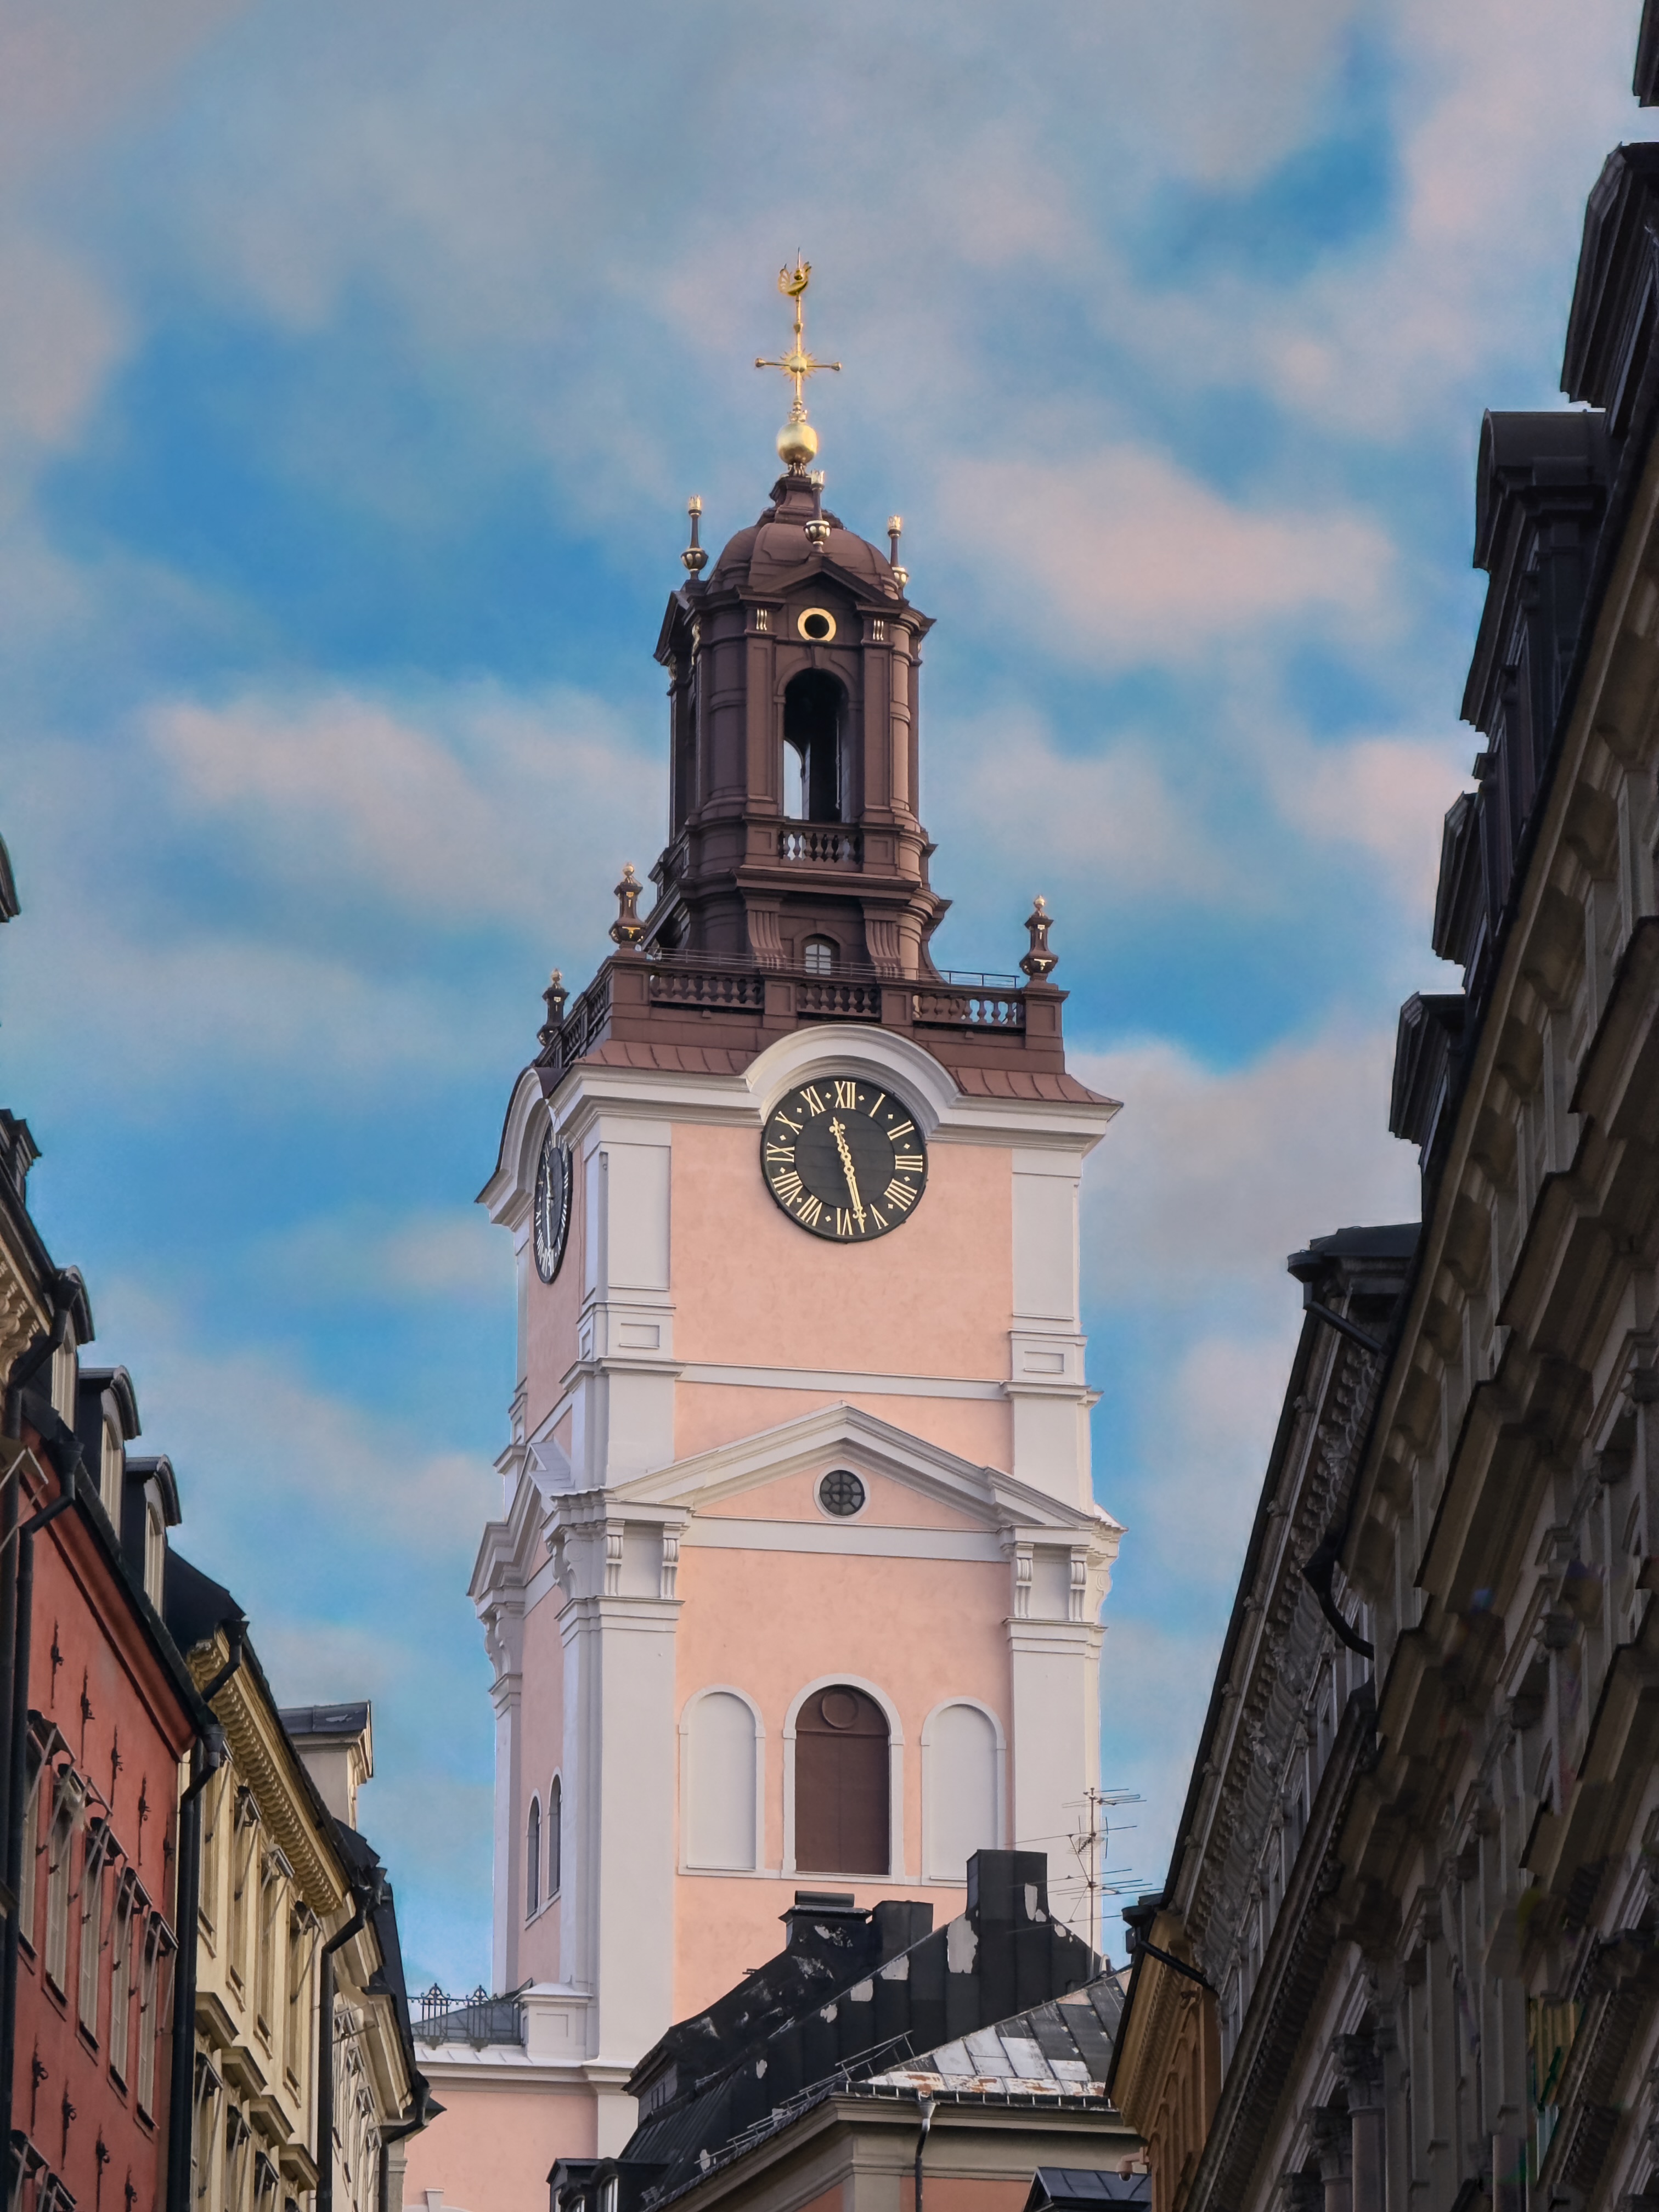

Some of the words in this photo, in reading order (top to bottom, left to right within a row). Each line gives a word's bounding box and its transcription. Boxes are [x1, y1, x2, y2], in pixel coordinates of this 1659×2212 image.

[800, 1086, 826, 1116] XI
[834, 1081, 856, 1109] XII
[868, 1093, 885, 1118] I
[775, 1111, 803, 1135] X
[887, 1120, 915, 1141] II
[766, 1142, 795, 1163] IX
[895, 1154, 923, 1172] III
[771, 1171, 803, 1207] VIII
[884, 1178, 918, 1212] IIII
[796, 1194, 822, 1226] VII
[836, 1207, 854, 1235] VI
[870, 1203, 889, 1229] V
